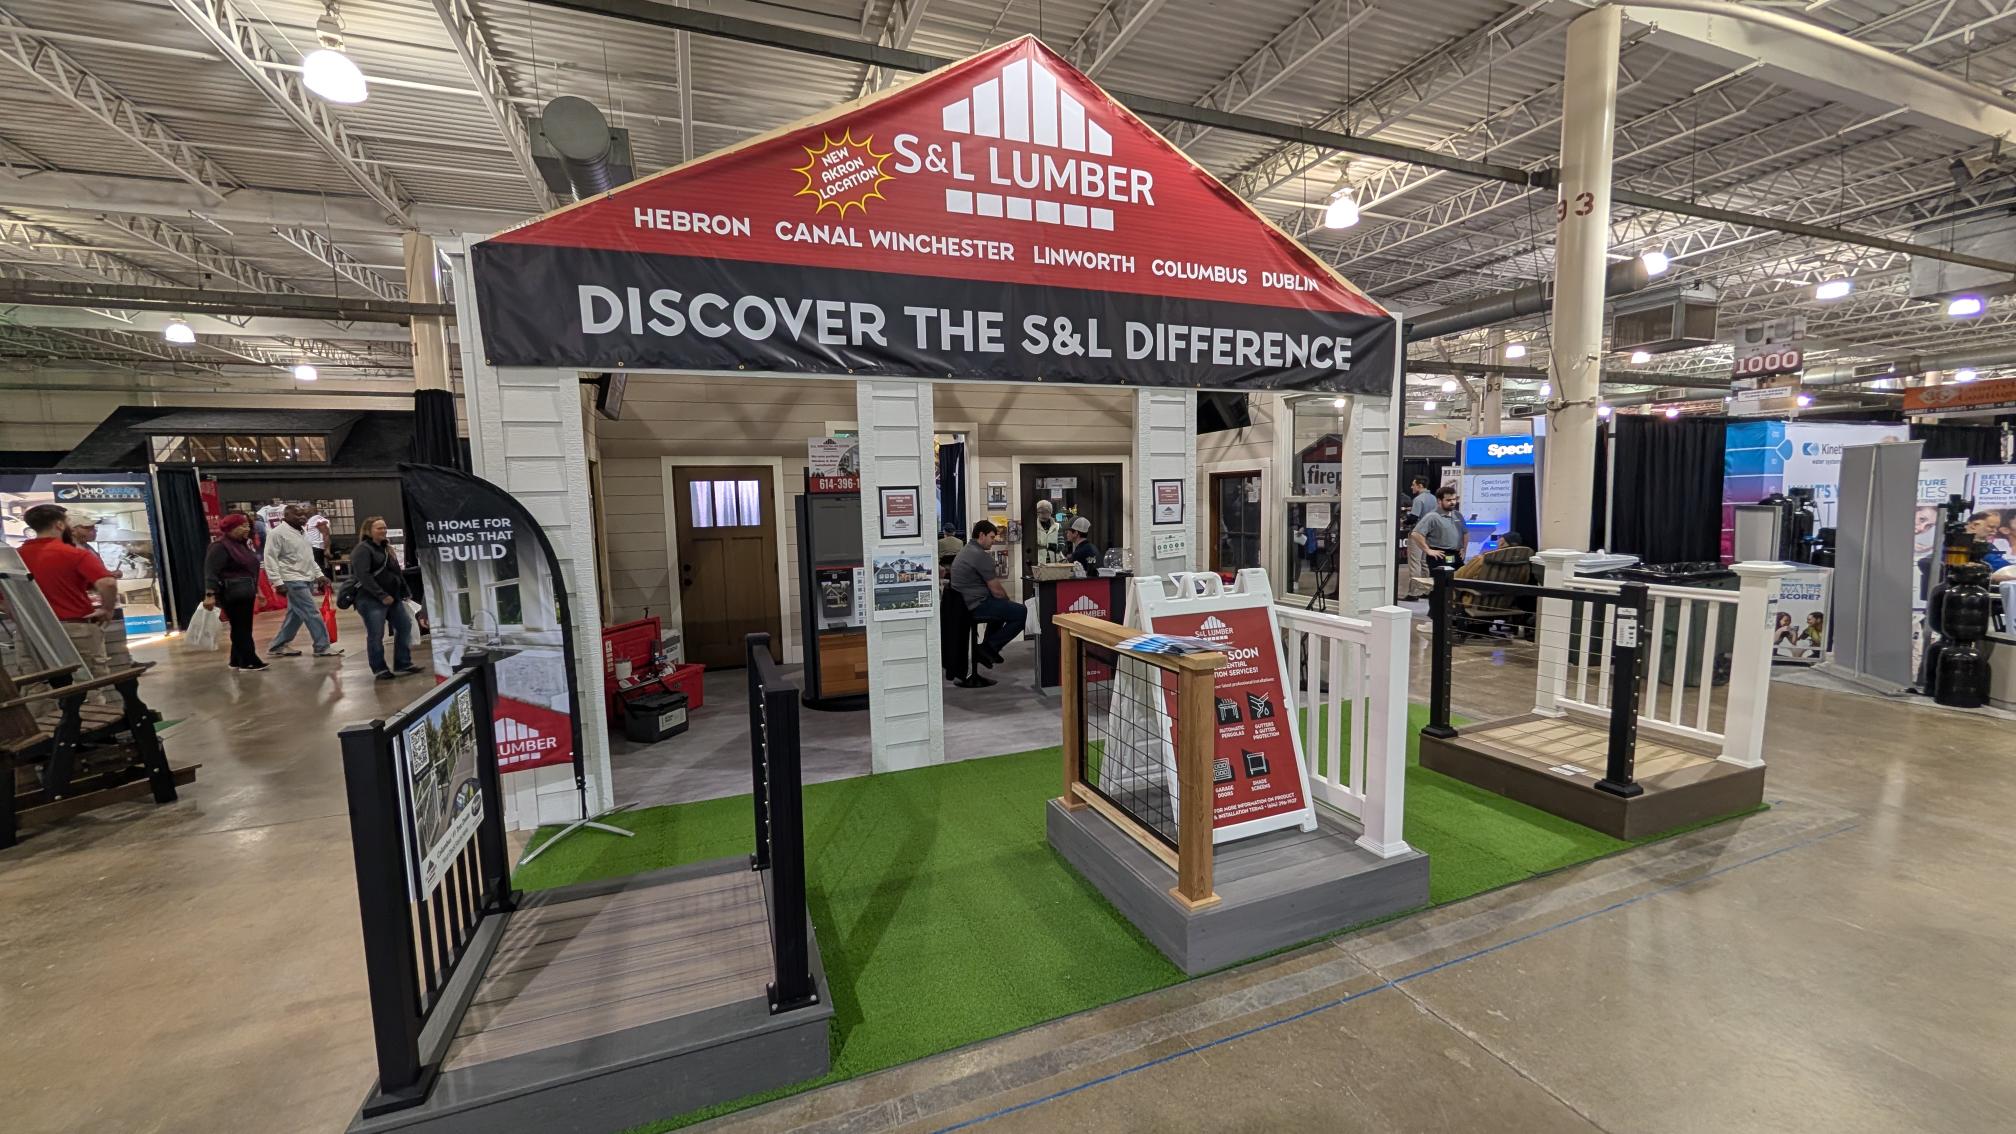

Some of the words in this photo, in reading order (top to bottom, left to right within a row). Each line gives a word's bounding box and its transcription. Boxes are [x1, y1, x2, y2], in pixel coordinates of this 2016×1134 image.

[821, 147, 849, 167] NEW
[821, 157, 864, 183] AKRON
[894, 134, 974, 181] S&L
[990, 147, 1154, 206] LUMBER
[820, 166, 879, 199] LOCATION
[634, 207, 750, 237] HEBRON
[775, 221, 863, 248] CANAL
[869, 230, 1014, 261] WINCHESTER
[1033, 246, 1135, 273] LINWORTH
[1152, 259, 1247, 284] COLUMBUS
[1262, 272, 1319, 291] DUBLIN
[578, 285, 887, 346] DISCOVER
[904, 306, 1005, 352] THE
[1021, 314, 1112, 358] S&L
[1125, 321, 1352, 371] DIFFERENCE
[1736, 351, 1798, 374] 1000
[438, 519, 480, 531] HOME
[484, 518, 511, 529] FOR
[428, 532, 475, 544] HANDS
[477, 530, 514, 541] THAT
[438, 544, 507, 562] BUILD
[1208, 627, 1234, 636] LUMBER
[1228, 647, 1259, 660] SOON
[1229, 667, 1258, 677] SERVICES!
[1221, 730, 1245, 739] PERGOLAS
[1253, 731, 1279, 740] PROTECTION
[497, 737, 557, 756] UMBER
[1237, 798, 1266, 809] INFORMATION
[1275, 792, 1295, 800] PRODUCT
[1218, 809, 1249, 819] INSTALLATION
